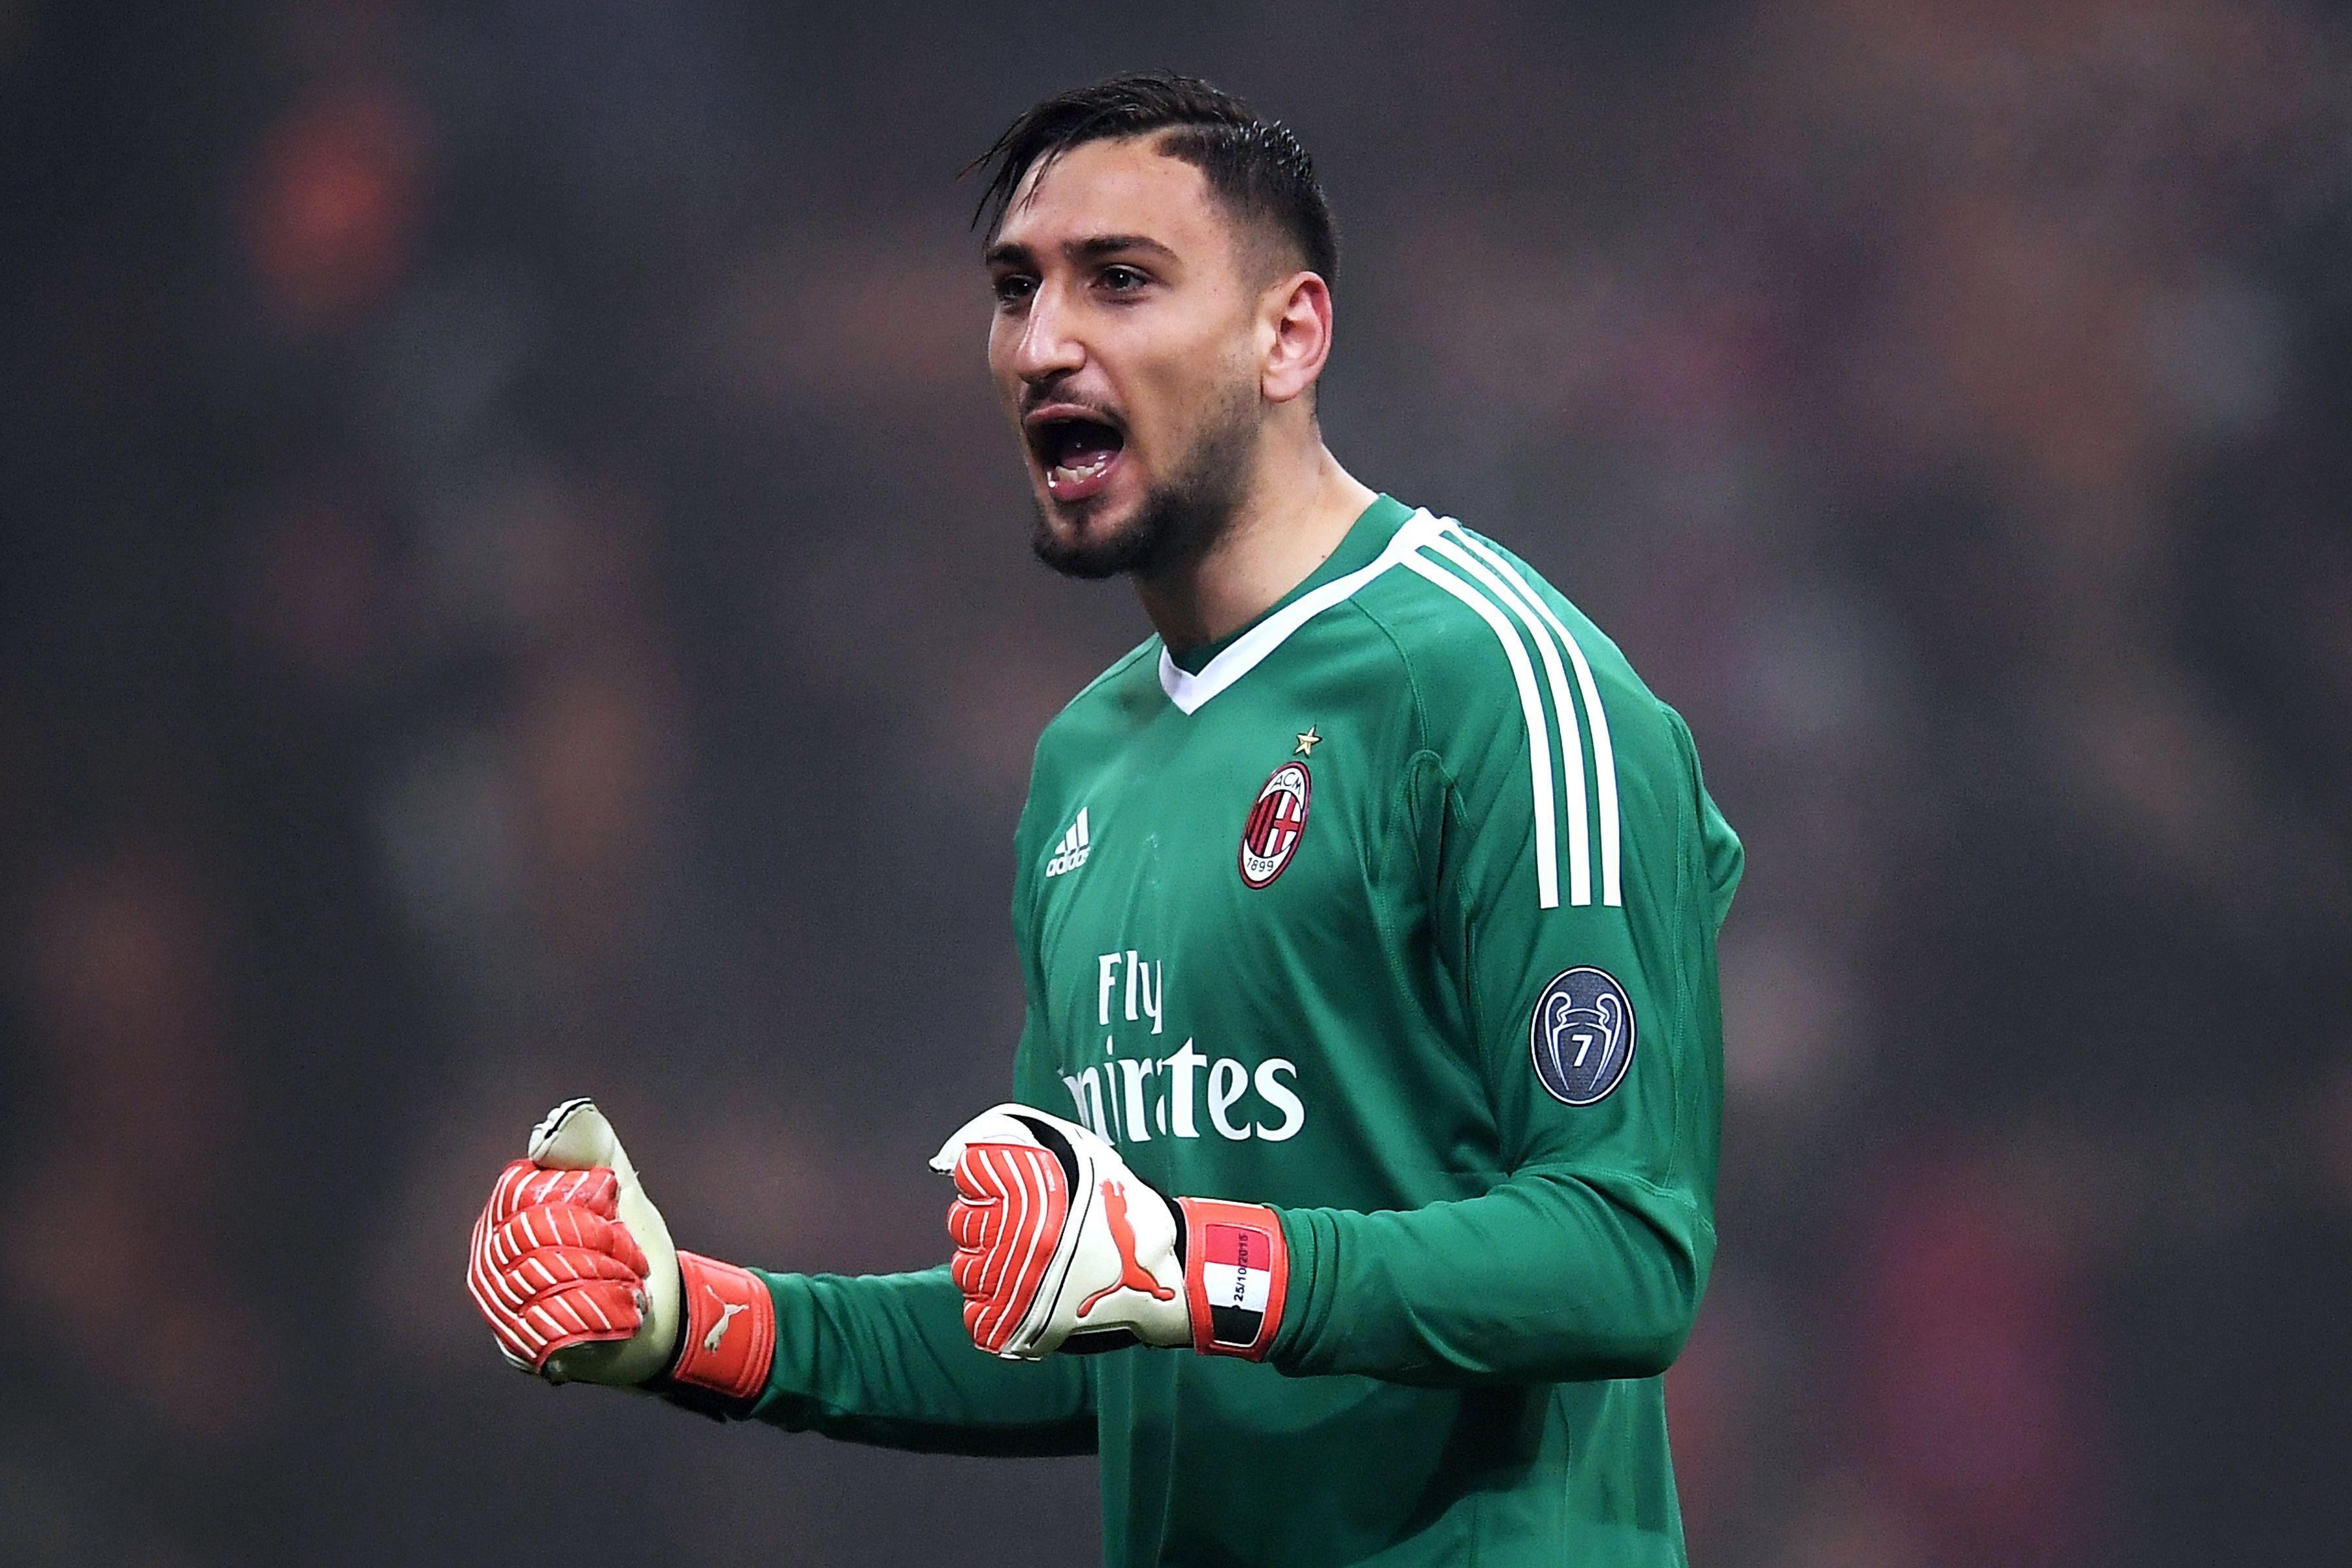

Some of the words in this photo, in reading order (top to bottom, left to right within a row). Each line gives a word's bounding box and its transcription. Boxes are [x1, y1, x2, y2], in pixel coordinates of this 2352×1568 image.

[1270, 772, 1301, 794] ACM
[1046, 846, 1091, 877] adidas
[1247, 858, 1274, 872] 1899
[1099, 950, 1162, 1035] Fly
[1572, 1034, 1593, 1067] 7
